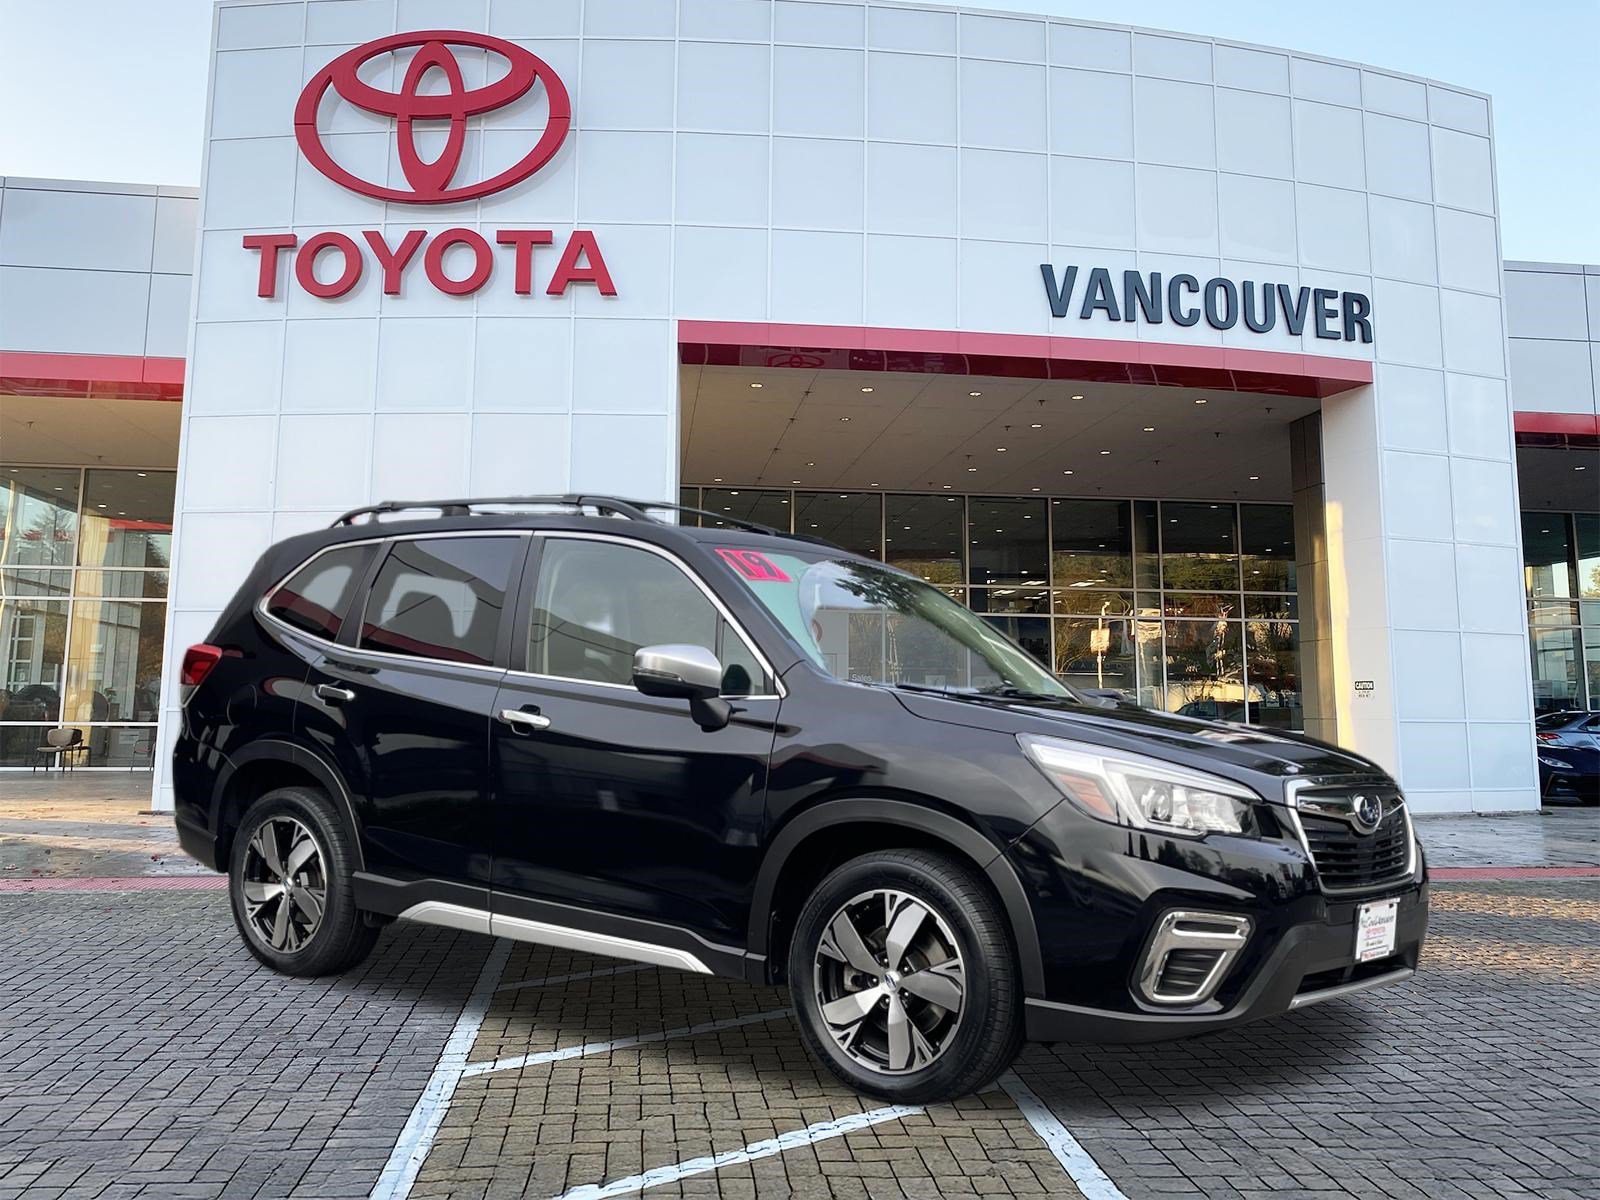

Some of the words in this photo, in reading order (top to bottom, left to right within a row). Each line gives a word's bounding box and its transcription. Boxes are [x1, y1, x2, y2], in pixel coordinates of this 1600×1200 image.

[243, 228, 617, 299] TOYOTA
[1040, 263, 1372, 343] VANCOUVER
[722, 551, 777, 577] 19
[851, 673, 872, 682] Sales
